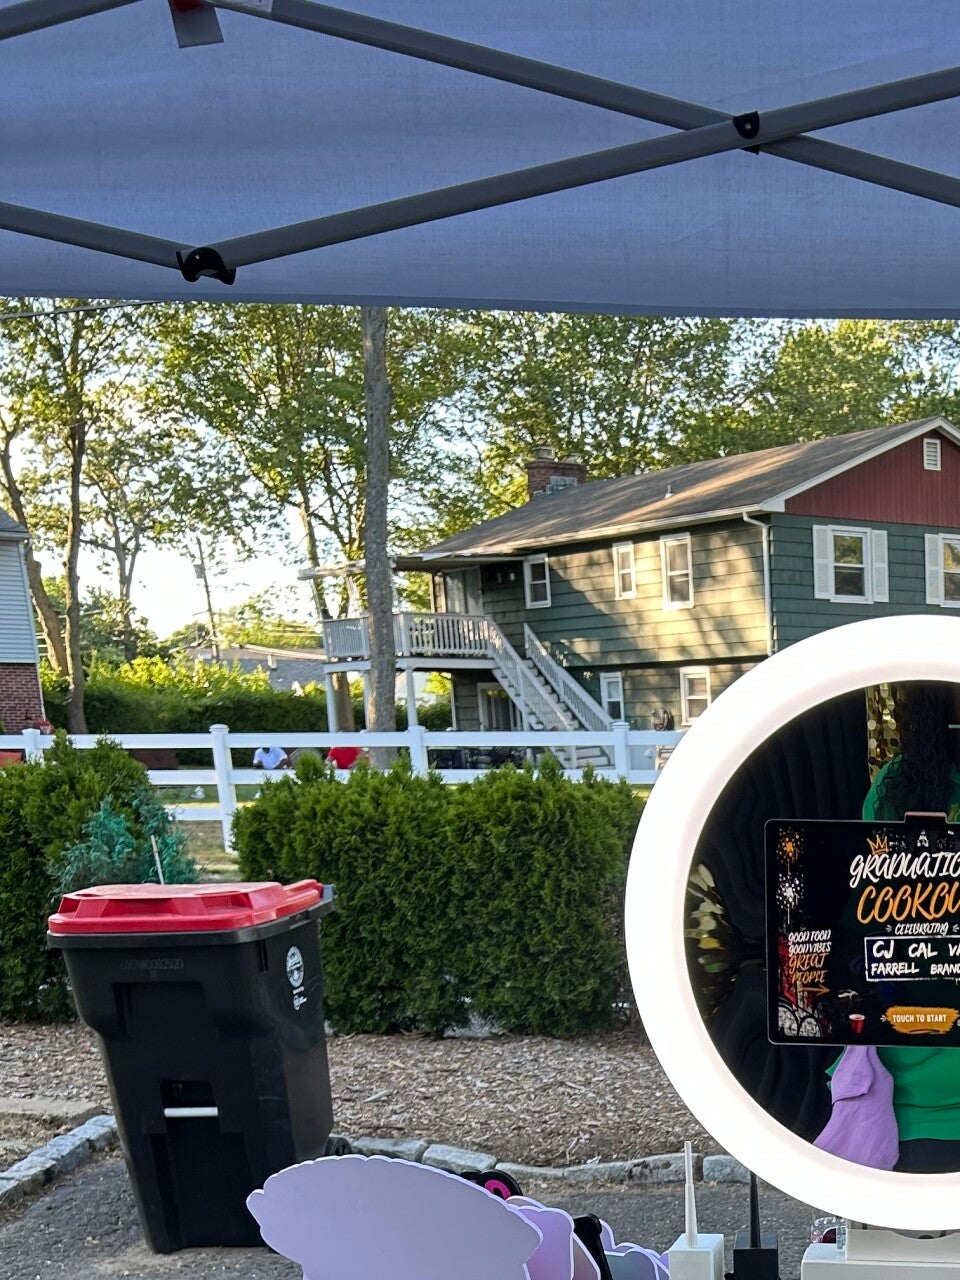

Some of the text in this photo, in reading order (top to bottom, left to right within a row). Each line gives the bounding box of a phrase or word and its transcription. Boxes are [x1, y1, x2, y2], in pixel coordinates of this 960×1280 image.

[872, 939, 895, 959] CJ
[908, 942, 938, 960] CAL
[788, 953, 830, 975] GREAT
[871, 962, 920, 976] FARRELL
[791, 970, 828, 984] PEOPLE
[892, 1013, 948, 1023] TOUCH TO START
